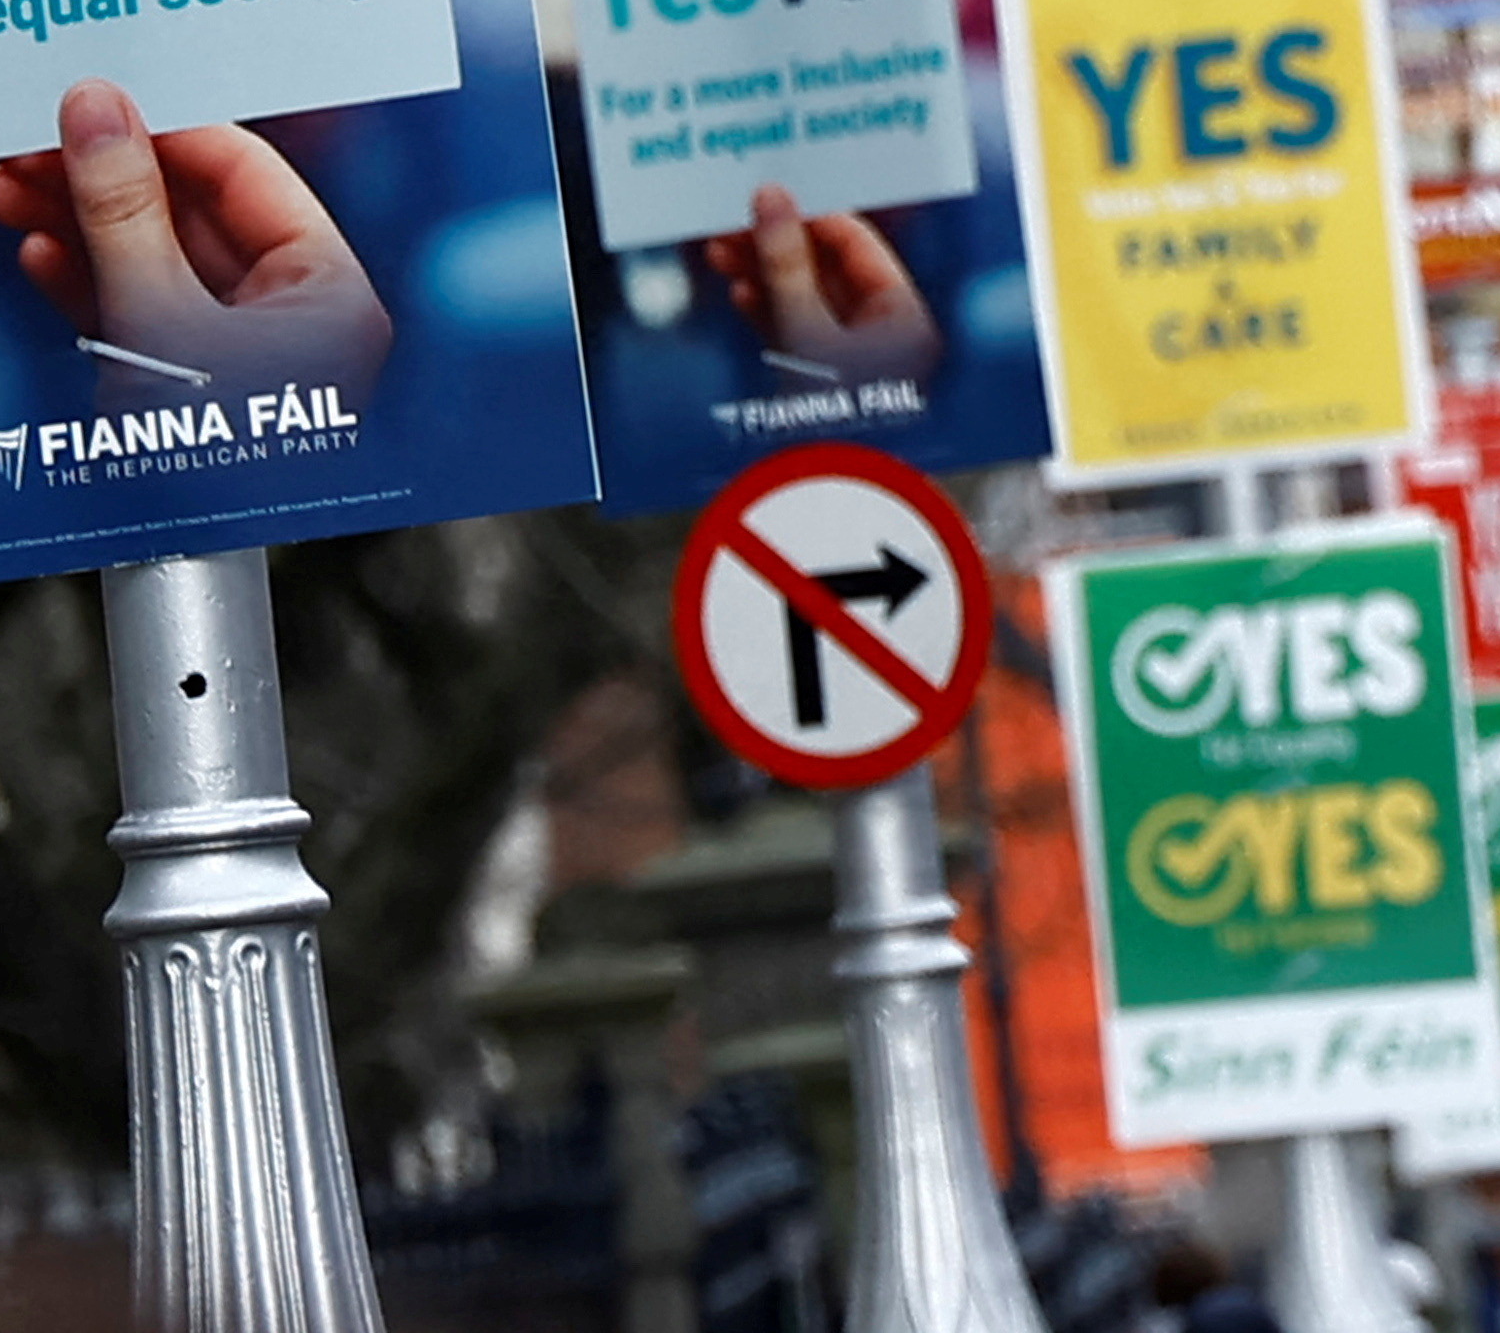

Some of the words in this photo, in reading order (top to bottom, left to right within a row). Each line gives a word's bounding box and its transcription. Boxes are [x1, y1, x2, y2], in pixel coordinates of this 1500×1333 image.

[601, 80, 653, 119] For
[664, 82, 687, 111] a
[696, 63, 781, 105] more
[791, 39, 946, 94] inclusive
[1068, 27, 1338, 167] YES
[629, 121, 692, 166] and
[703, 108, 796, 161] equal
[804, 89, 932, 137] society
[1117, 217, 1319, 274] FAMILY
[1150, 303, 1304, 363] CARE
[39, 399, 232, 466] FIANNA
[249, 383, 358, 438] FÁIL
[741, 383, 852, 434] FIANNA
[44, 466, 92, 488] THE
[107, 444, 268, 480] REPUBLICAN
[281, 429, 361, 455] PARTY
[1220, 592, 1425, 725] YES
[1237, 780, 1440, 912] YES
[1138, 1037, 1293, 1103] Sinn
